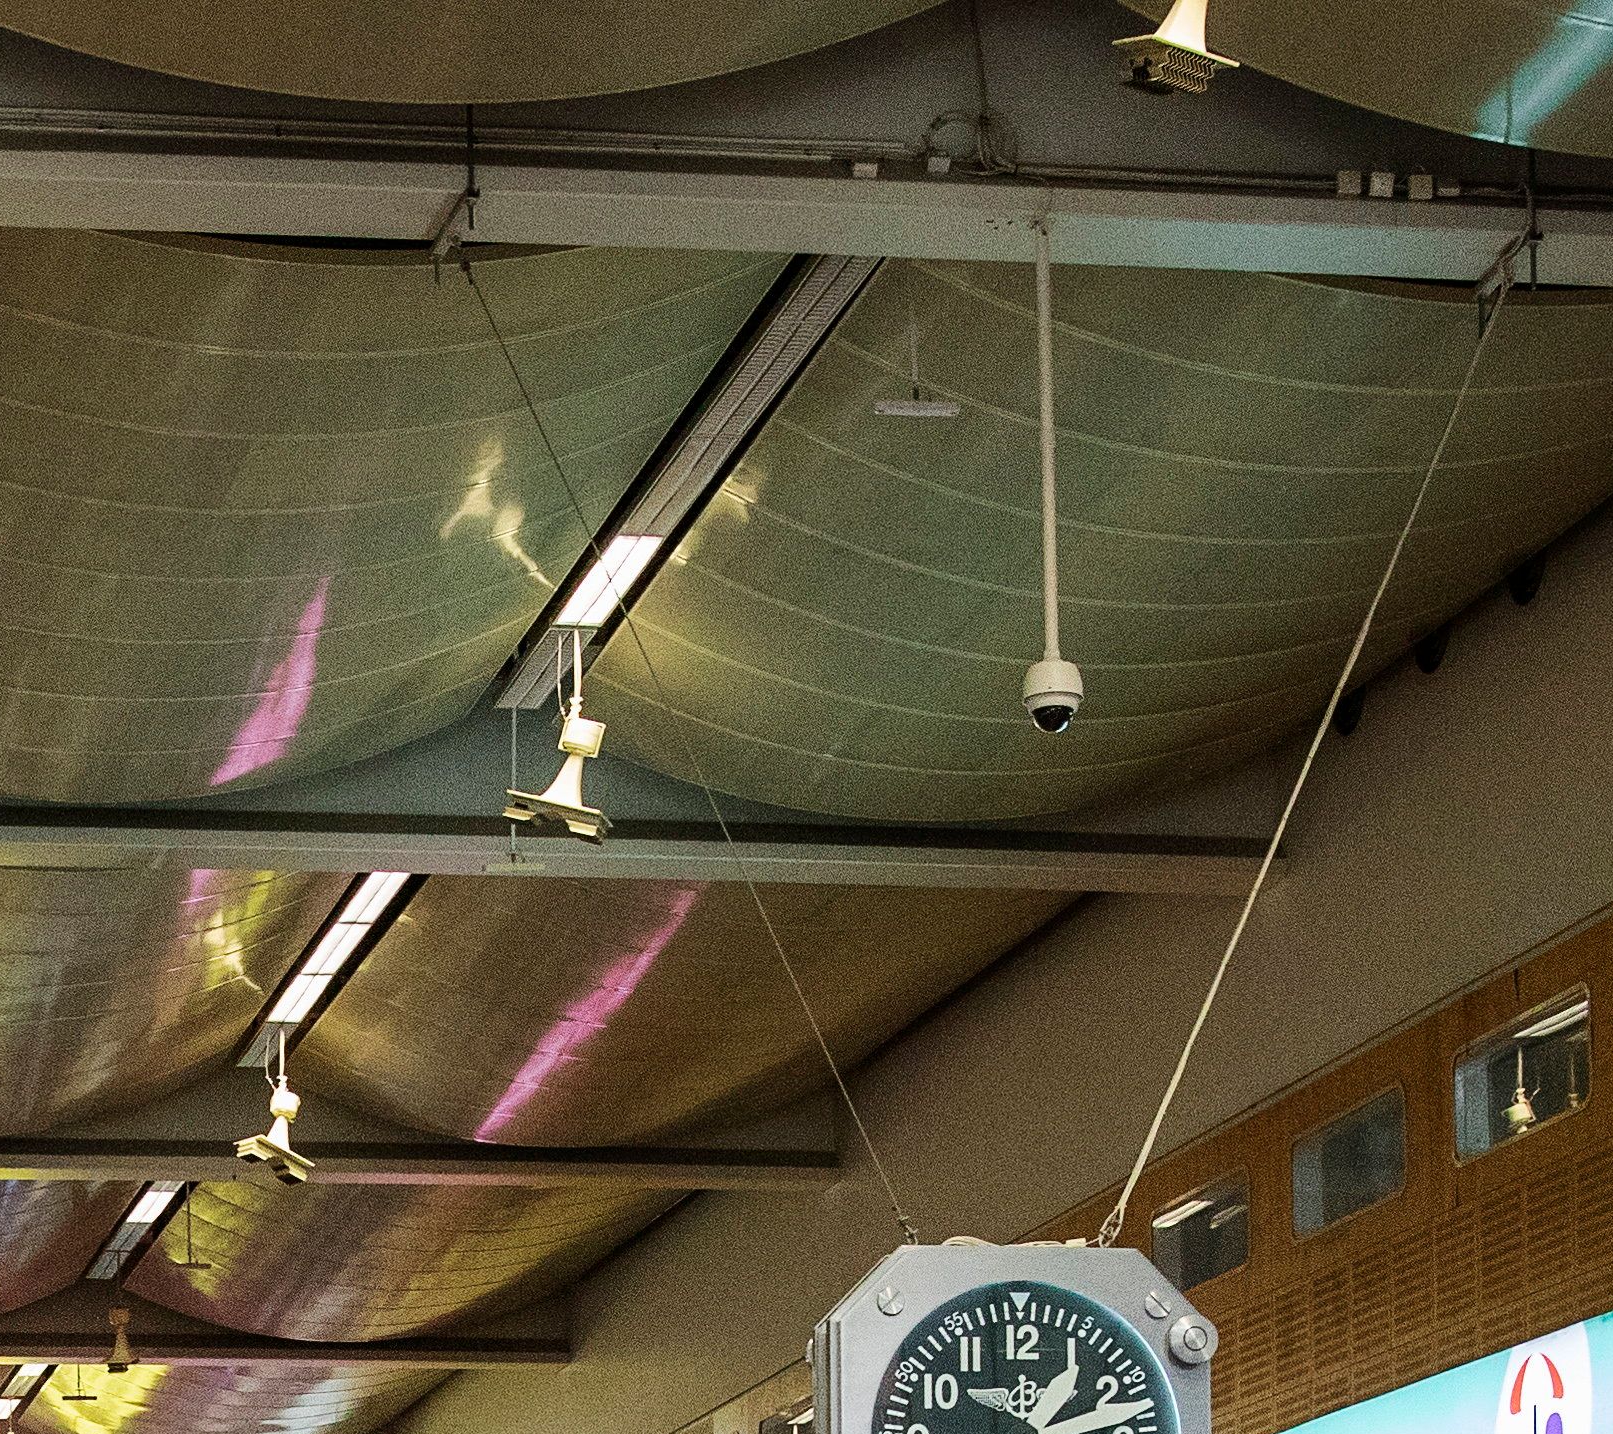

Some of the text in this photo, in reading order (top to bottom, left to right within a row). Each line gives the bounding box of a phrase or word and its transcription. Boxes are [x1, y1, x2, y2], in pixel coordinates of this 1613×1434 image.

[944, 1311, 963, 1330] 55
[1082, 1316, 1094, 1330] 5
[960, 1336, 981, 1372] 11
[1005, 1325, 1039, 1360] 12
[895, 1362, 913, 1381] 50
[1130, 1366, 1145, 1382] 10
[924, 1374, 958, 1410] 10
[1096, 1375, 1118, 1408] 2
